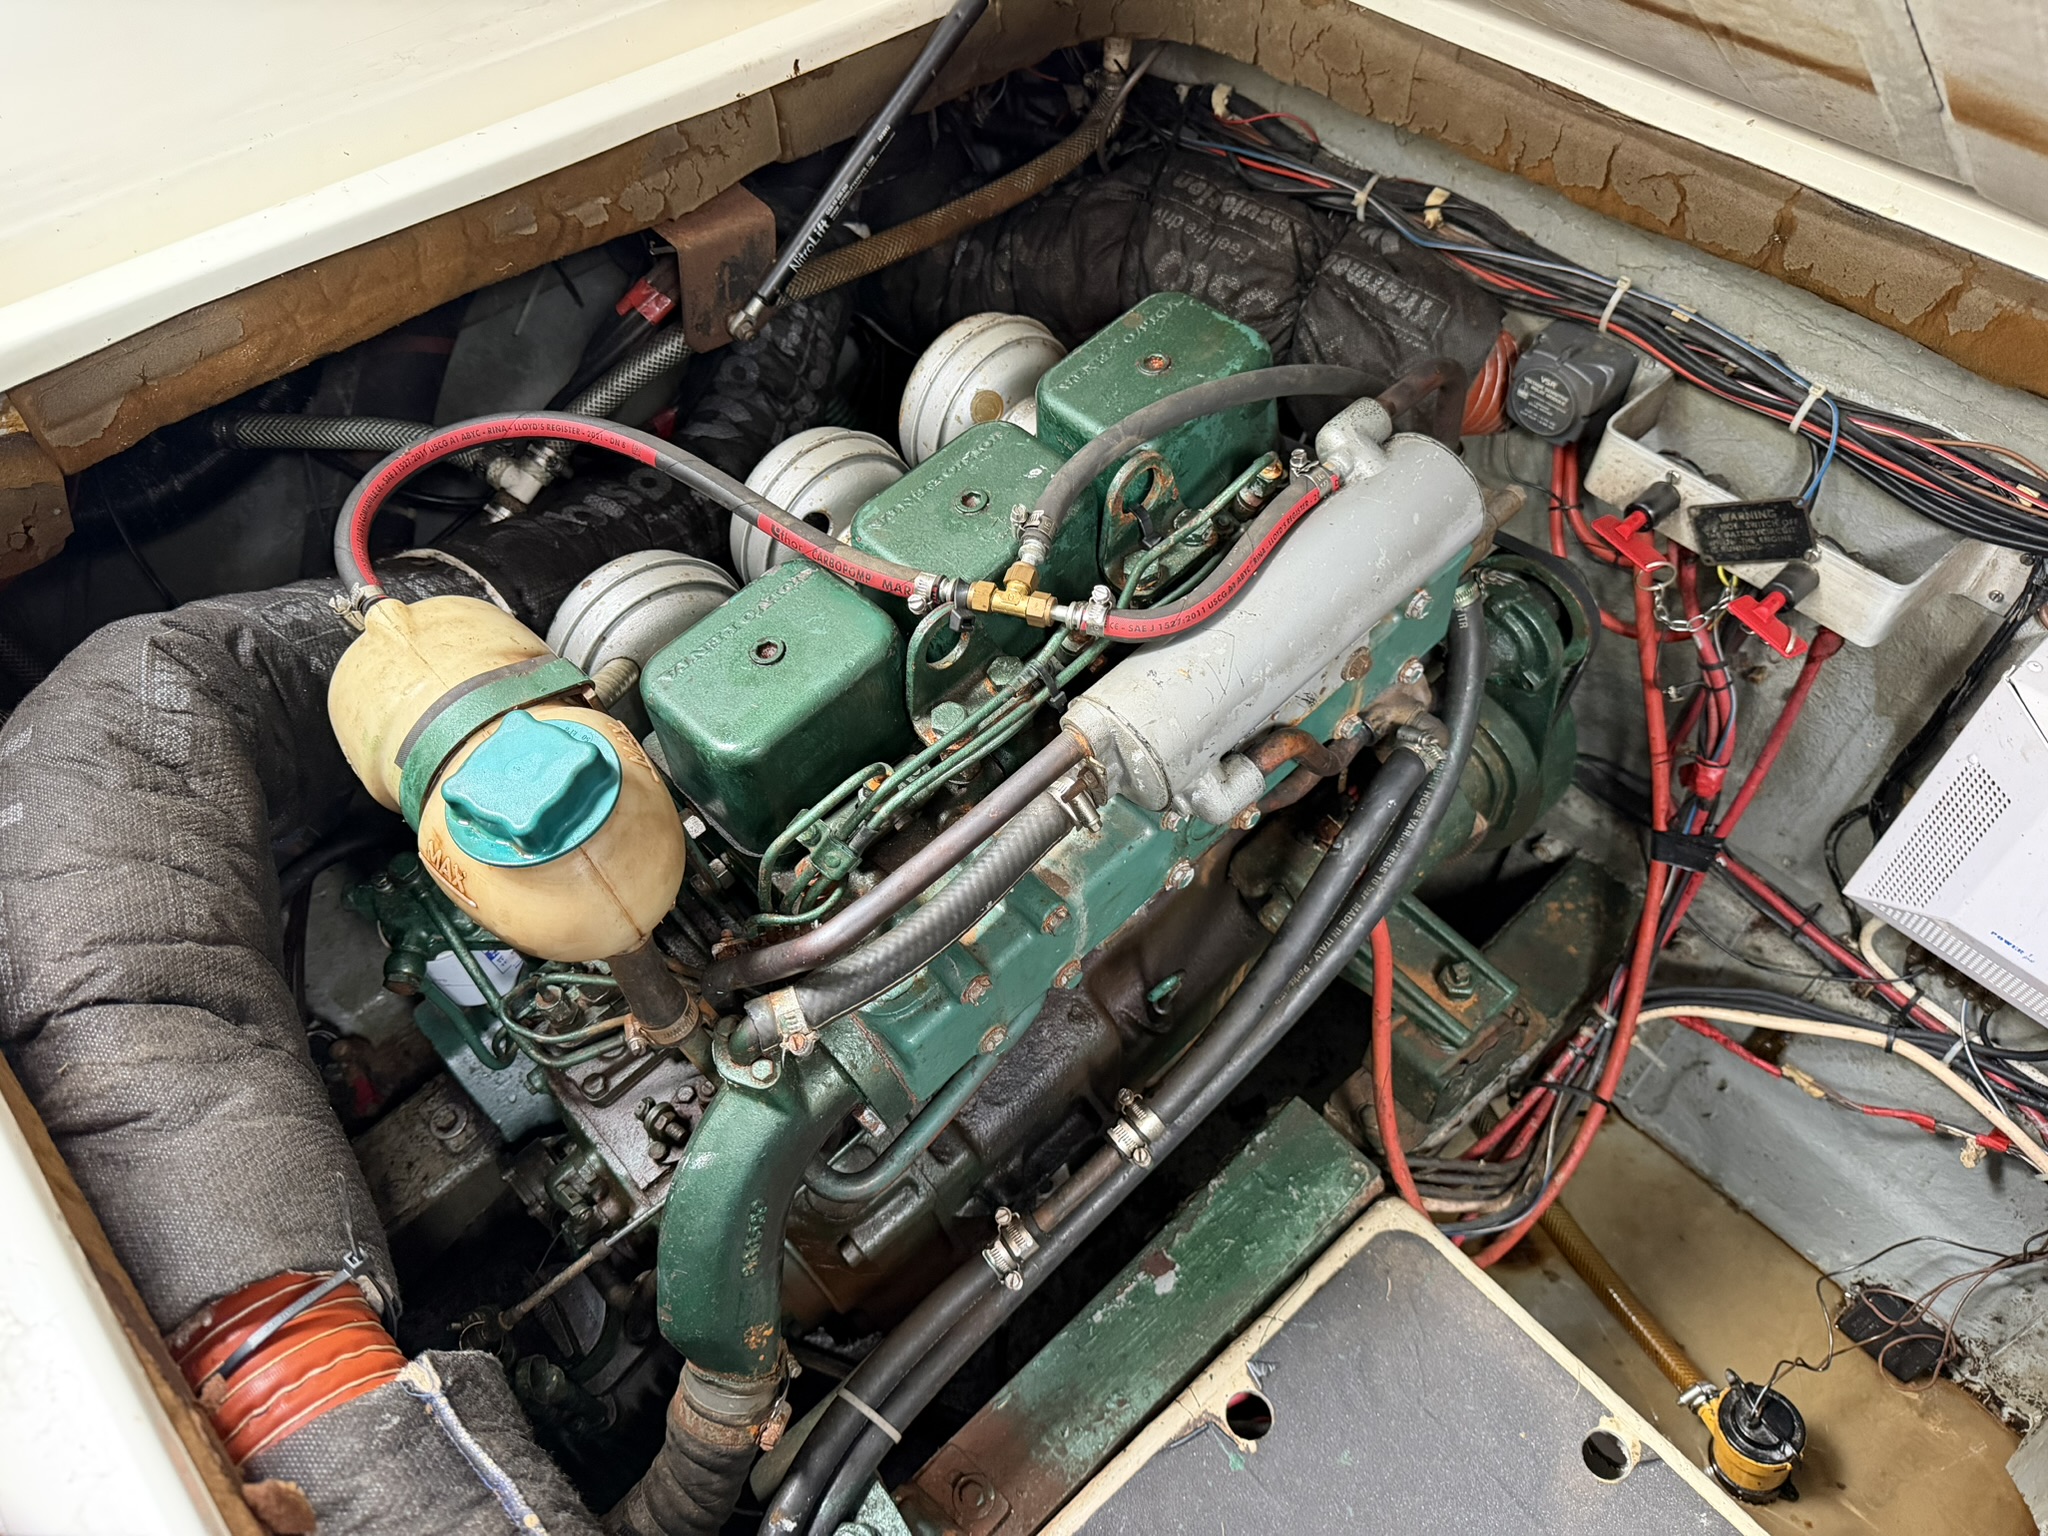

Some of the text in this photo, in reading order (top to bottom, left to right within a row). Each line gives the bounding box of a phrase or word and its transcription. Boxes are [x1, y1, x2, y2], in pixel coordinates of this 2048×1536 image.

[789, 219, 830, 273] NitroLift
[1541, 376, 1558, 389] VSR
[383, 472, 395, 485] SAE
[429, 439, 449, 453] USCG
[450, 436, 461, 445] A1
[461, 430, 481, 442] ABYC
[487, 426, 507, 435] RINA
[514, 423, 545, 431] LLOYD'S
[545, 424, 581, 436] REGISTER
[587, 431, 604, 441] 2021
[1719, 509, 1778, 522] WARNING
[1744, 520, 1780, 530] SWITCH
[1128, 624, 1148, 633] SAE
[1158, 606, 1207, 631] 1527:2011
[1207, 591, 1228, 610] USCG
[1236, 565, 1252, 585] ABYC
[1253, 547, 1267, 566] RINA
[1268, 523, 1288, 547] LLOYD'S
[1286, 500, 1311, 526] REGISTER
[881, 579, 914, 597] MAR
[1414, 790, 1434, 819] HOSE
[425, 840, 468, 895] MAX
[1371, 875, 1381, 888] 10
[1339, 901, 1363, 929] MADE
[1329, 925, 1342, 940] IN
[1313, 933, 1335, 963] ITALY
